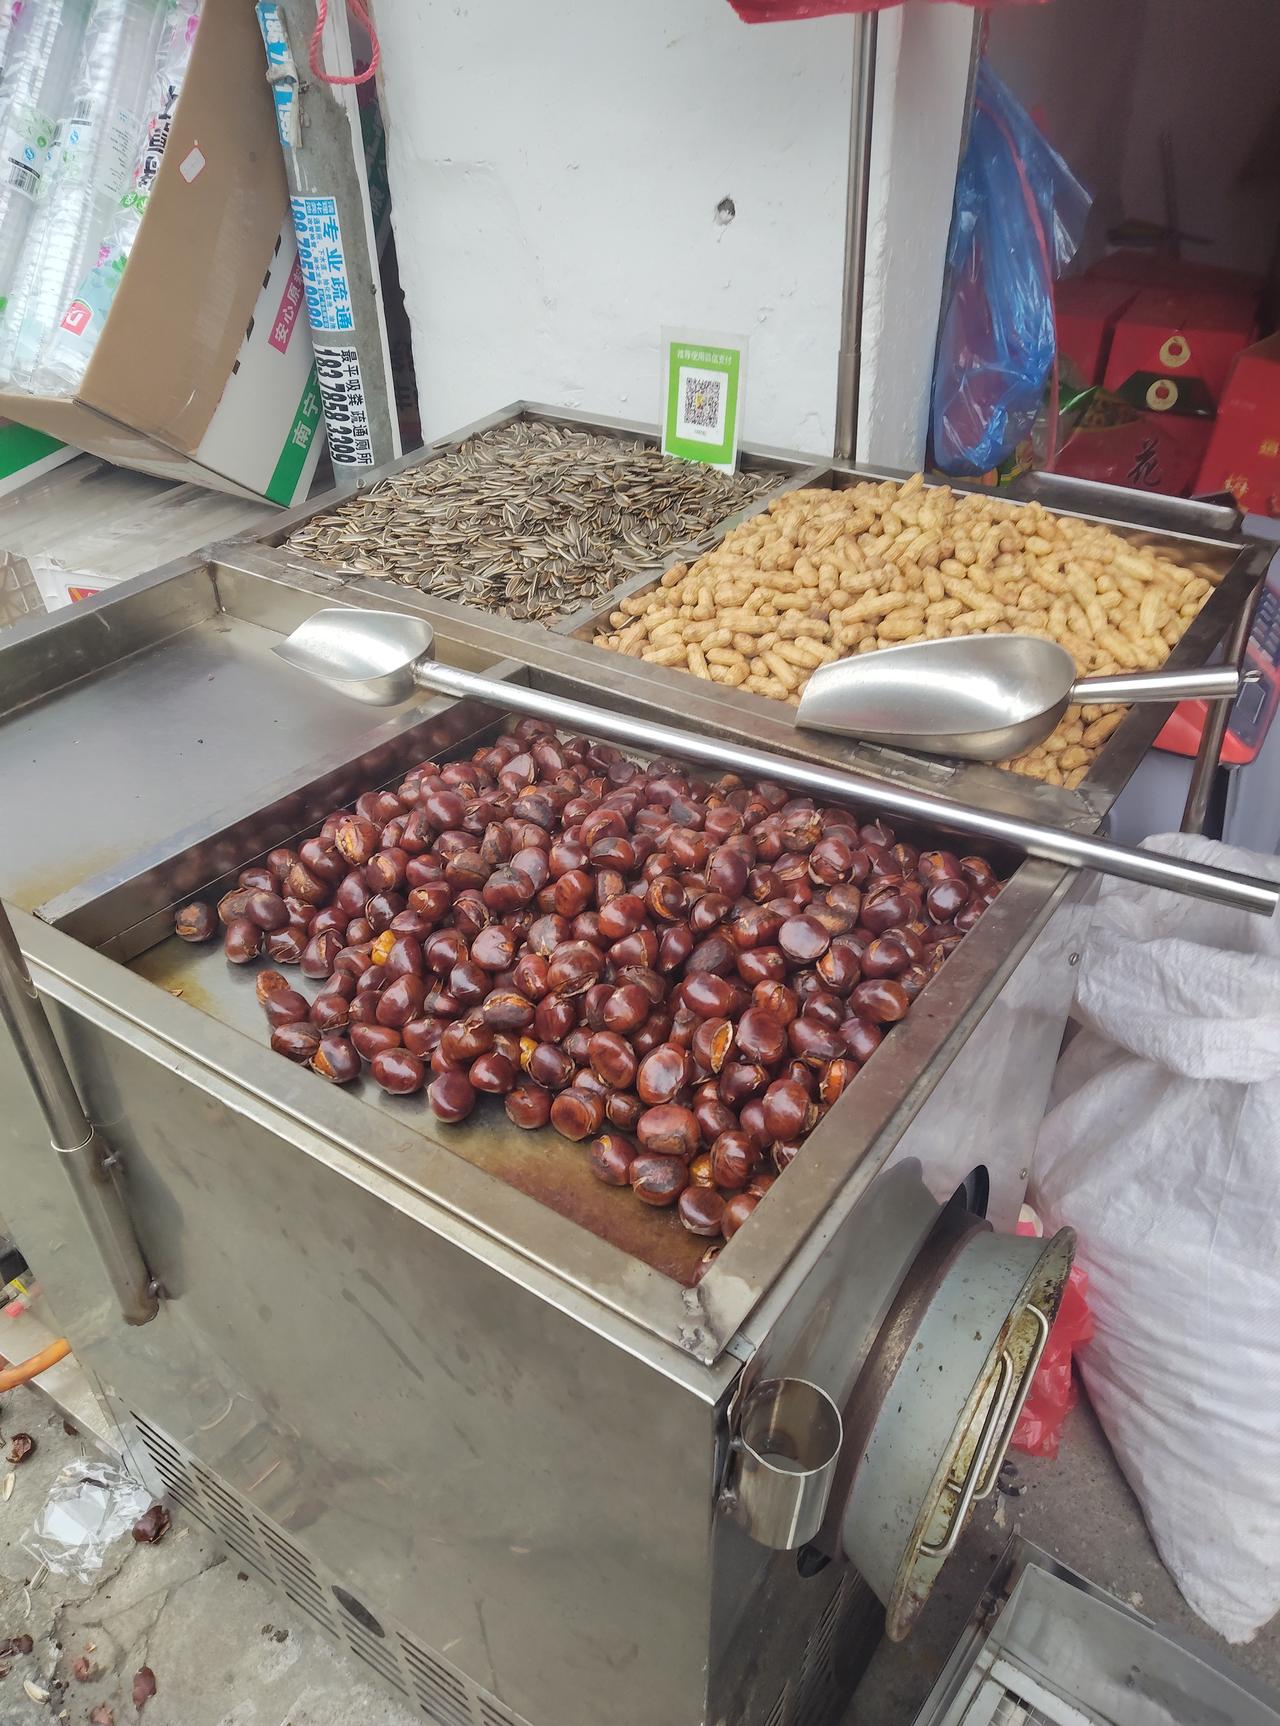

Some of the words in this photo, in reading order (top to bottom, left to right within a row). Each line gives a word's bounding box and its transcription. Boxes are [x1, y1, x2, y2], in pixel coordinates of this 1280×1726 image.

[323, 216, 352, 330] 专业疏通
[315, 349, 343, 378] 183
[320, 382, 350, 422] 7858
[326, 422, 357, 464] 3399
